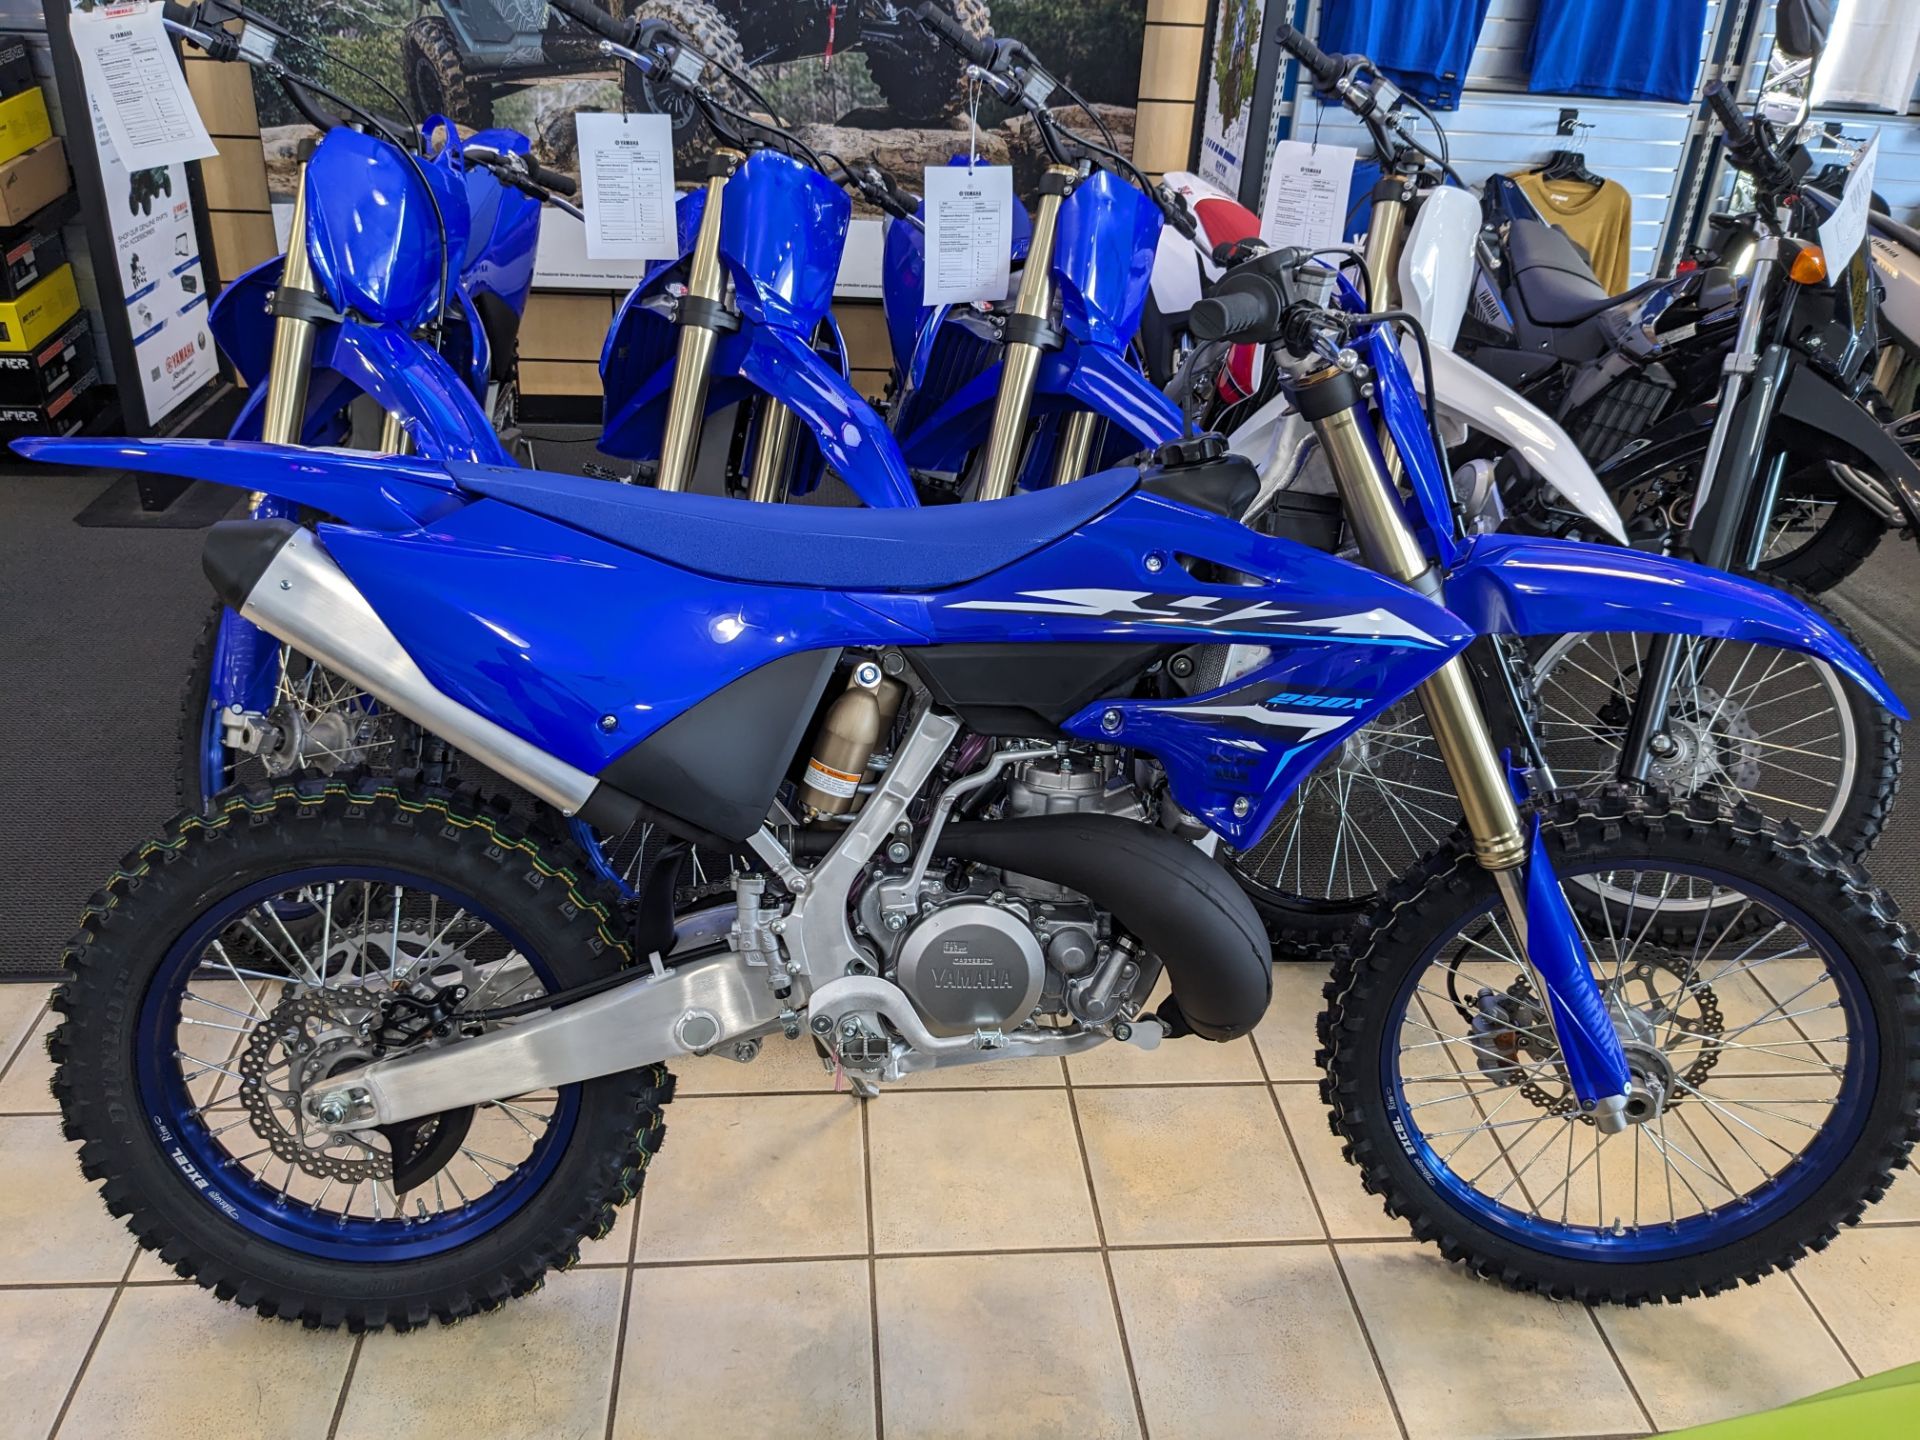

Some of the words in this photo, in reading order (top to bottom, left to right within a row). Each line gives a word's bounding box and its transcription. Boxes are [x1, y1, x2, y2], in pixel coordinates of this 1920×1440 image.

[115, 30, 133, 39] YAMAHA
[1872, 237, 1899, 258] YAMAHA
[1479, 288, 1500, 321] YAMAHA
[171, 341, 196, 369] YAMAHA
[1266, 692, 1374, 710] 250X
[931, 968, 1013, 989] YAMAHA
[1570, 966, 1617, 1057] YAMAHA
[1392, 1116, 1416, 1155] EXCEL
[171, 1146, 210, 1190] EXCEL
